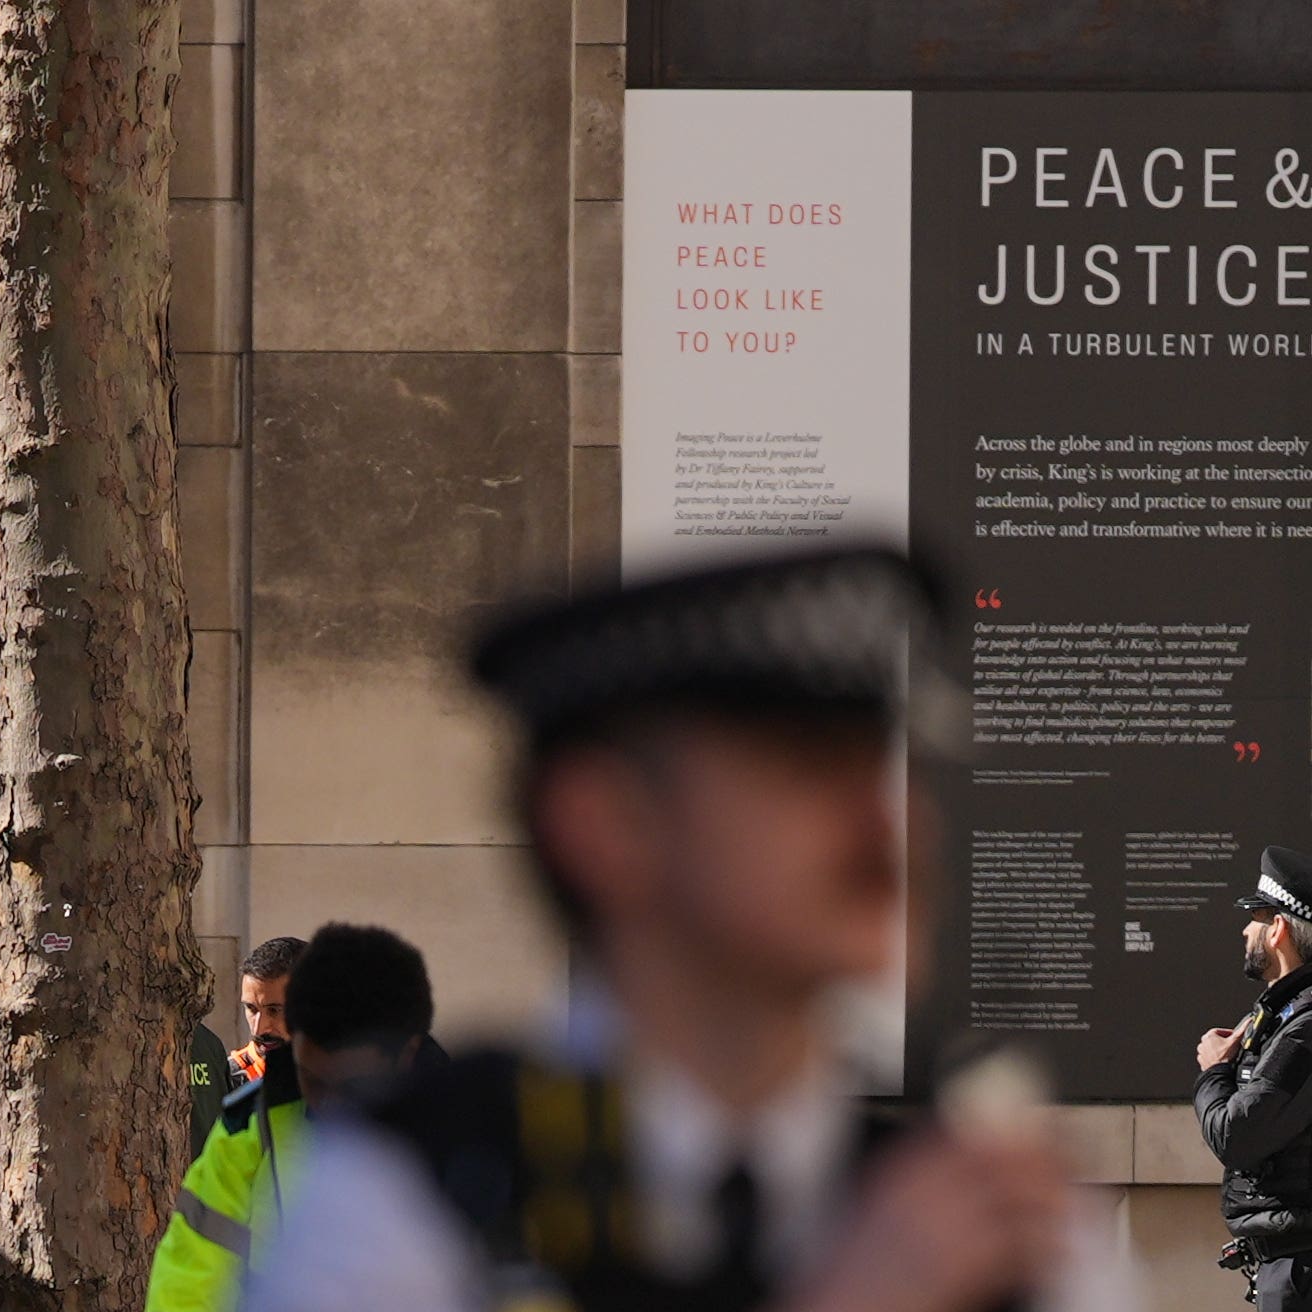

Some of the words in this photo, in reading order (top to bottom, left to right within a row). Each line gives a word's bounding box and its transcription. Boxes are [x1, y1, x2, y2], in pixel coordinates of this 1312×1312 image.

[982, 147, 1237, 208] PEACE
[1266, 148, 1312, 208] &
[677, 203, 752, 226] WHAT
[769, 203, 843, 226] DOES
[677, 246, 766, 268] PEACE
[978, 245, 1311, 306] JUSTICE
[677, 289, 749, 311] LOOK
[766, 289, 823, 311] LIKE
[677, 332, 709, 353] TO
[727, 332, 796, 353] YOU?
[977, 333, 1003, 355] IN
[1017, 333, 1033, 355] A
[1048, 333, 1213, 356] TURBULENT
[1228, 334, 1312, 356] WORL
[975, 436, 1026, 451] Across
[1031, 436, 1055, 451] the
[1060, 436, 1101, 455] globe
[1106, 436, 1133, 451] and
[1138, 436, 1153, 451] in
[1158, 437, 1212, 455] regions
[1217, 438, 1253, 451] most
[1258, 437, 1309, 456] deeply
[977, 464, 995, 483] by
[1000, 464, 1043, 481] crisis,
[1101, 464, 1113, 480] is
[1118, 464, 1181, 484] working
[1185, 467, 1199, 480] at
[1204, 464, 1228, 480] the
[1234, 465, 1312, 480] intersectio
[976, 492, 1053, 510] academia,
[1058, 492, 1106, 511] policy
[1111, 493, 1140, 508] and
[1145, 493, 1205, 511] practice
[1210, 495, 1226, 508] to
[1231, 497, 1281, 508] ensure
[976, 521, 987, 536] is
[992, 520, 1055, 536] effective
[1060, 521, 1088, 537] and
[1092, 521, 1201, 537] transformative
[1205, 521, 1252, 537] where
[1256, 521, 1266, 537] it
[1271, 521, 1283, 537] is
[1287, 525, 1312, 537] nee
